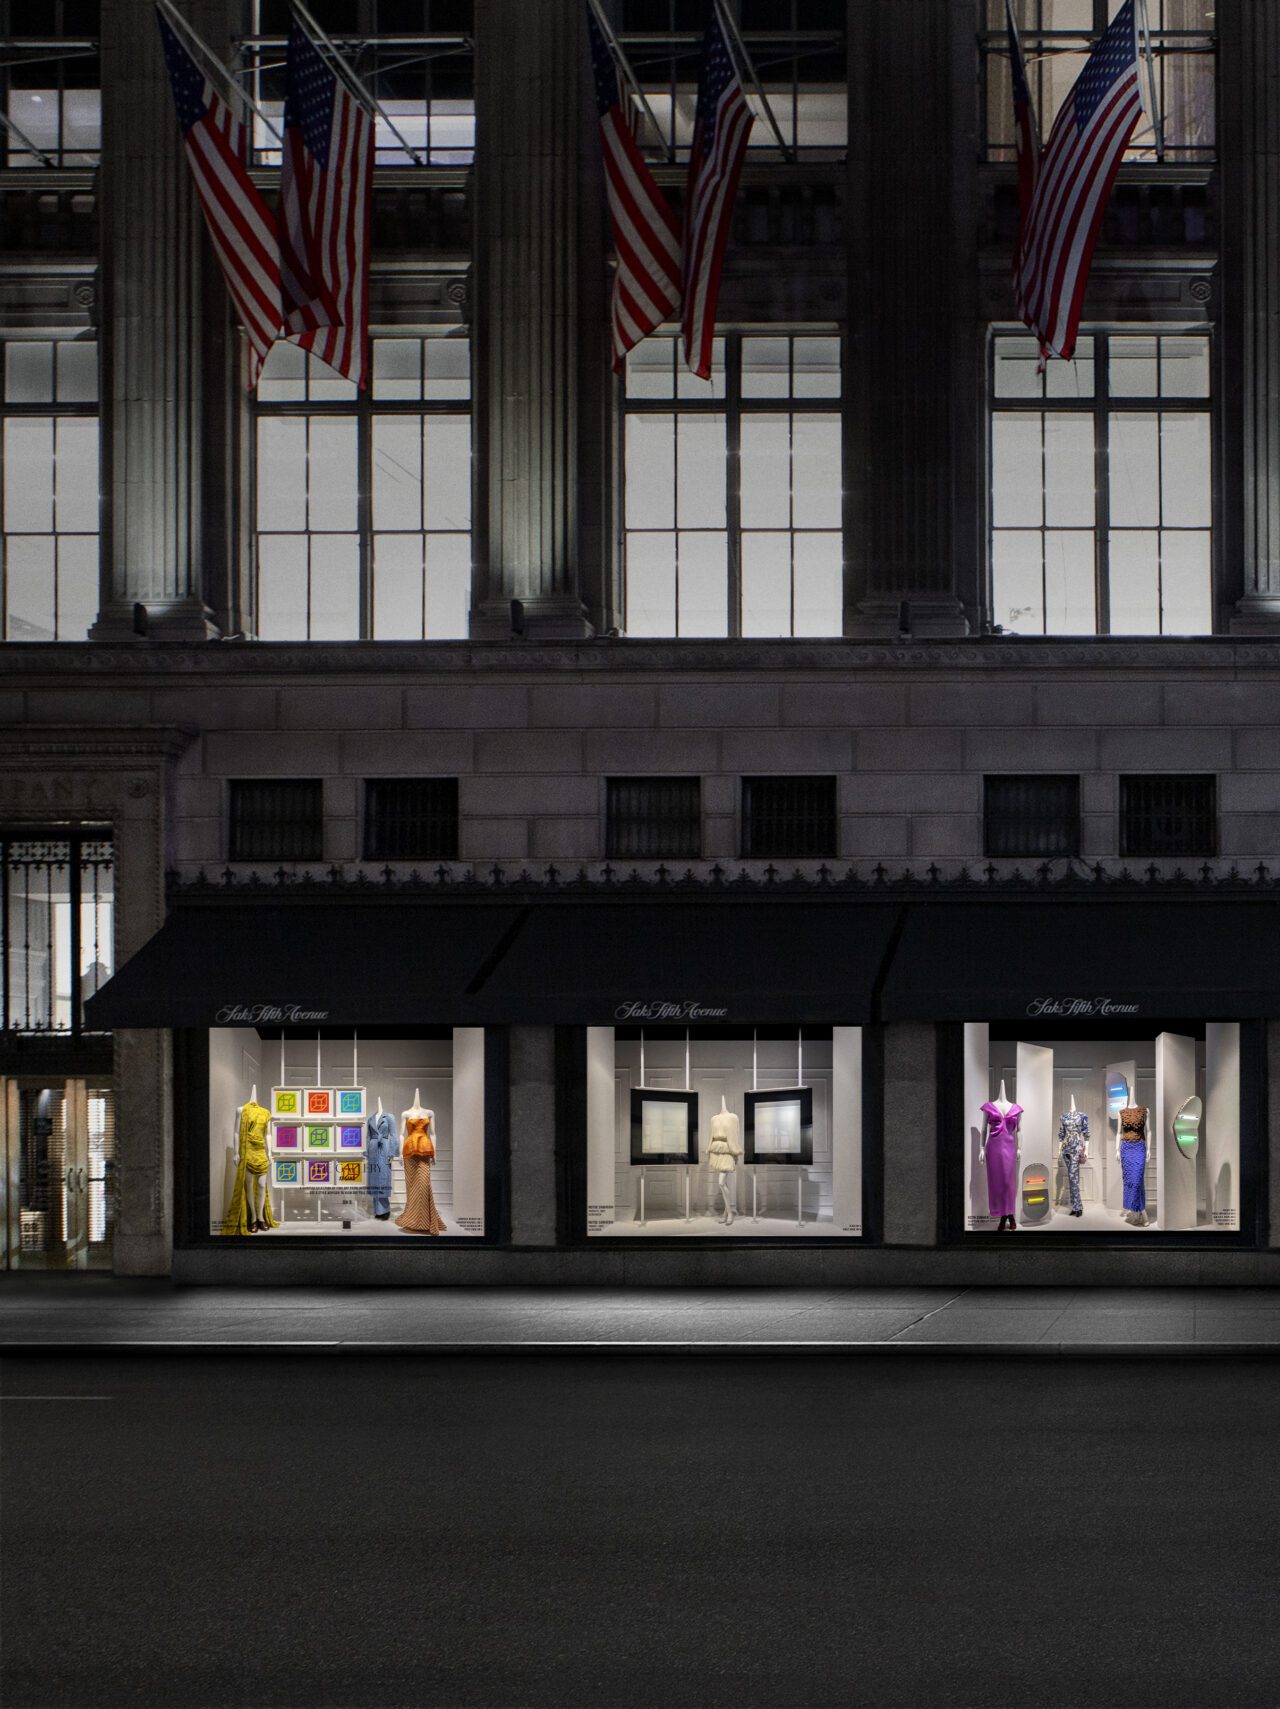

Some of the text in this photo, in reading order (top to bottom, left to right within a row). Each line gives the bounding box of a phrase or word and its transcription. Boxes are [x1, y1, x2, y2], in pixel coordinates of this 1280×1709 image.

[0, 778, 98, 801] PANY
[216, 1004, 329, 1023] Saks Fifth Avenue
[614, 1001, 728, 1020] Saks Fifth Avenue
[1026, 997, 1139, 1016] Saks Fifth Avenue
